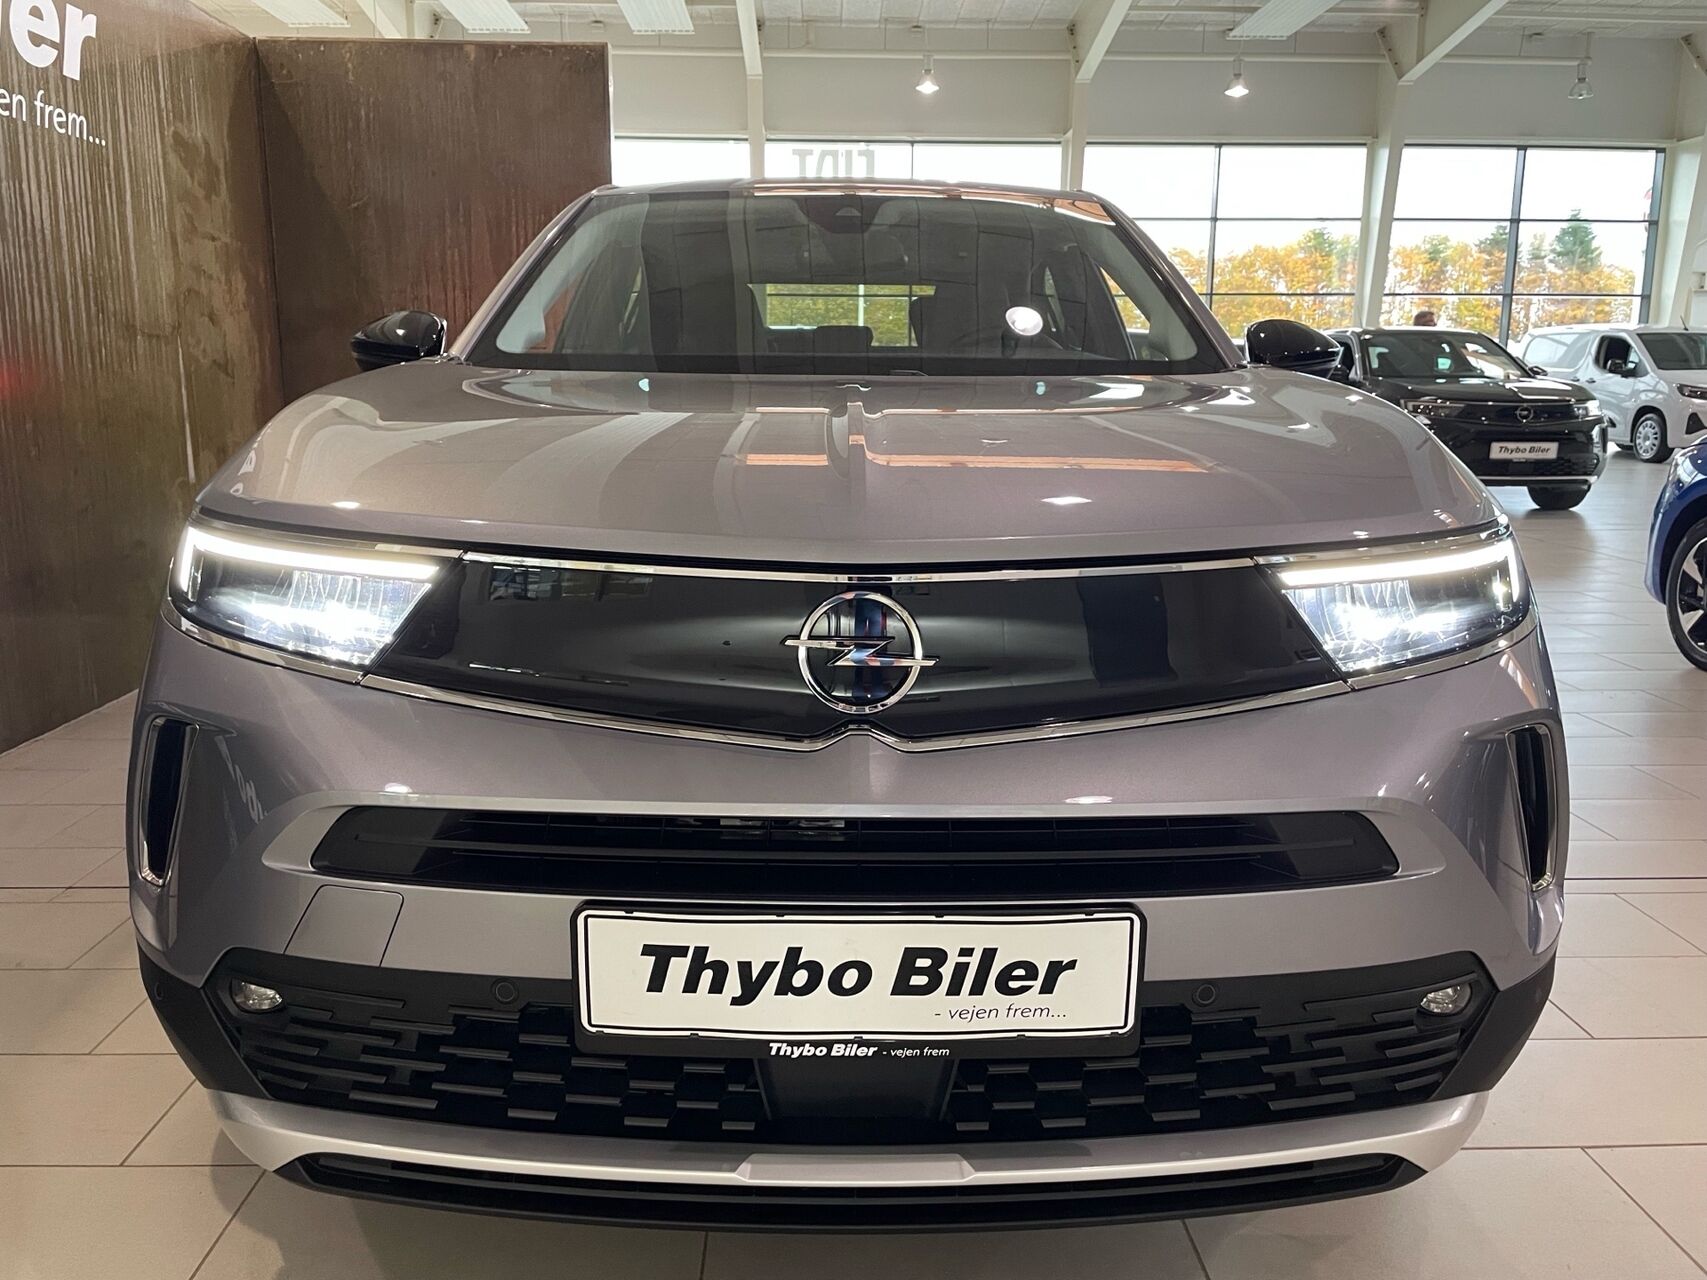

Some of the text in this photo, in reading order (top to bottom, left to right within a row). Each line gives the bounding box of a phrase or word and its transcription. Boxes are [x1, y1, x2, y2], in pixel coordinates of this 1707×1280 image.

[0, 0, 97, 81] er
[34, 89, 106, 147] frem...
[1498, 446, 1551, 455] Thybo Biler
[640, 943, 1078, 1006] Thybo Biler
[948, 1005, 999, 1023] vejen
[1005, 1002, 1067, 1018] frem...
[769, 1042, 828, 1058] Thybo
[830, 1043, 879, 1057] Biler
[890, 1047, 920, 1058] vejen
[923, 1046, 950, 1056] frem
